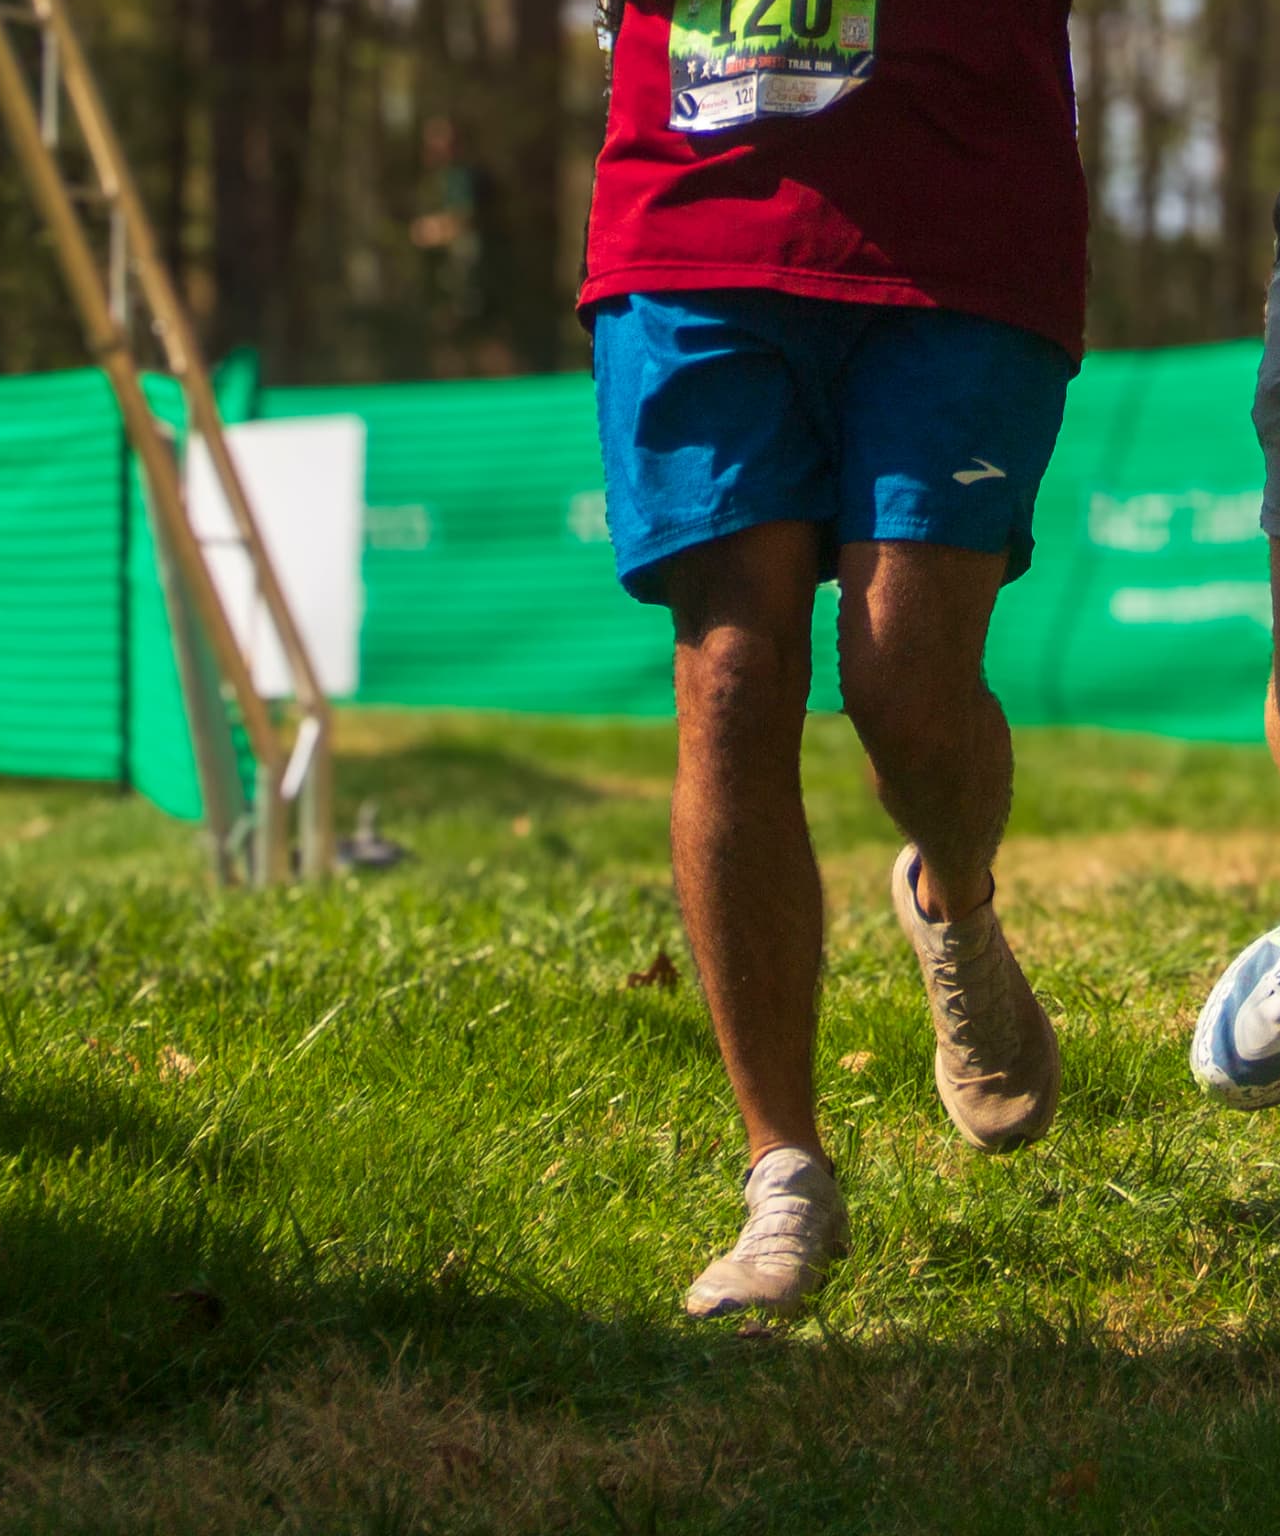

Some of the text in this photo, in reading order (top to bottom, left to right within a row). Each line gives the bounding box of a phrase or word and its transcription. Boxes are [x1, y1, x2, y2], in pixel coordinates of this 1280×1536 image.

[788, 58, 812, 71] TRAIL
[814, 60, 832, 72] RUN
[735, 87, 754, 106] 120
